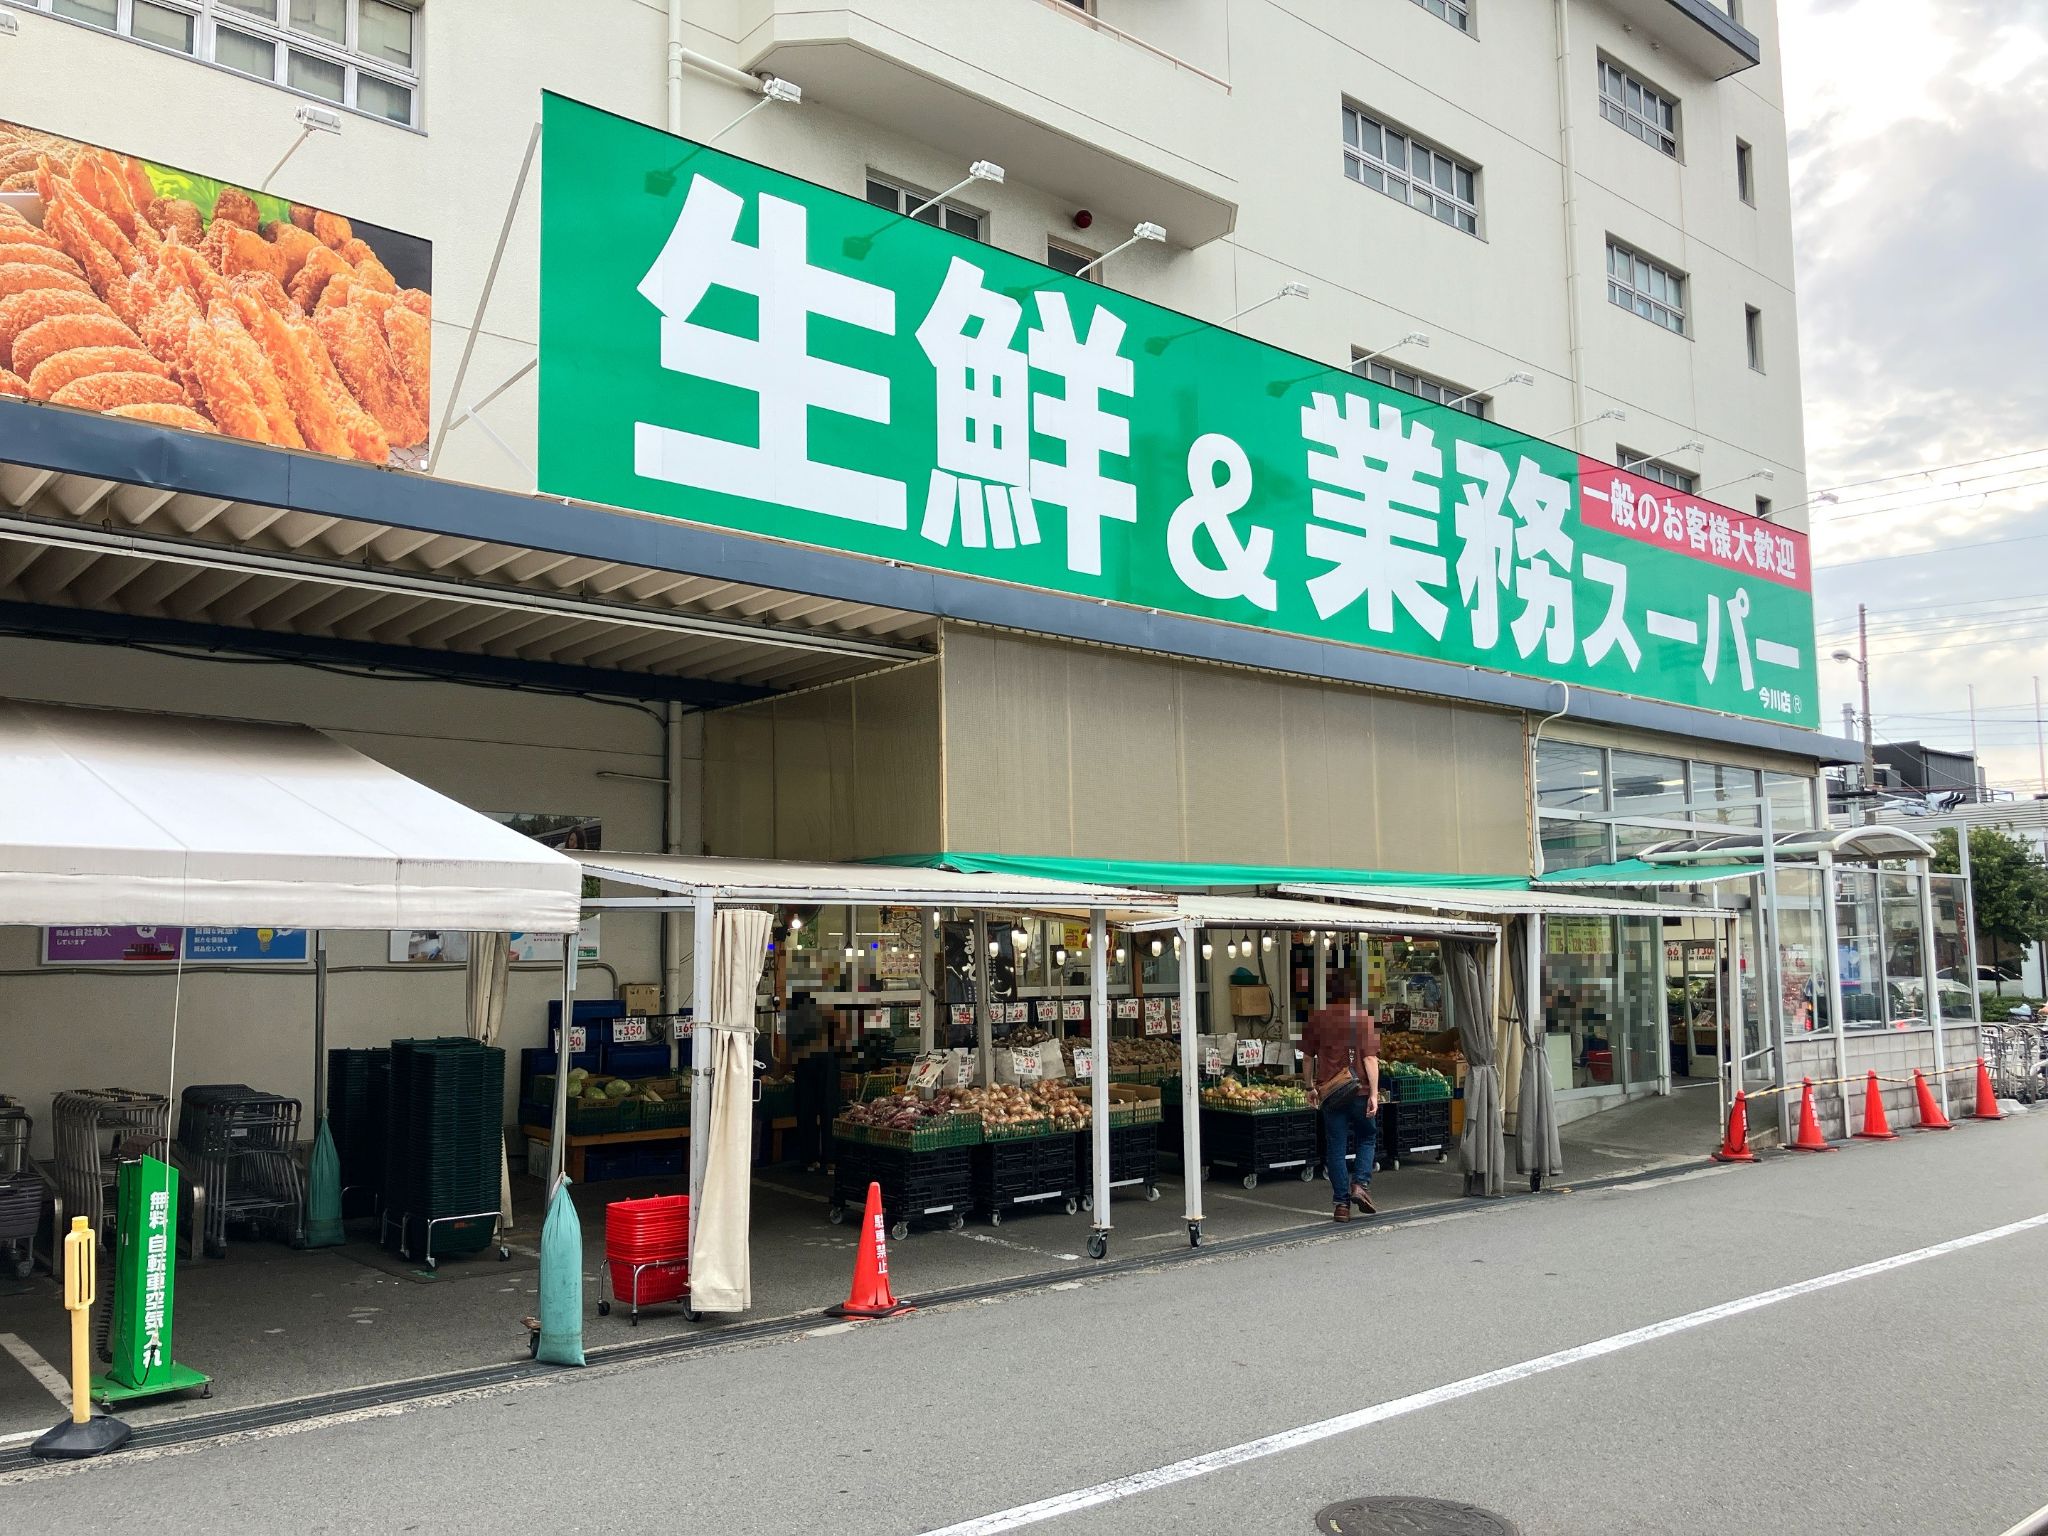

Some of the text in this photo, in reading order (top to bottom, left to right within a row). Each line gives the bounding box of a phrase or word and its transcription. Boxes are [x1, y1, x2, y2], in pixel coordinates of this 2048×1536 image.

[1583, 478, 1796, 580] 一般のお客様大歓迎
[1758, 686, 1791, 714] 今川店
[623, 1025, 642, 1036] 350
[1418, 1018, 1435, 1027] 259
[149, 1191, 169, 1230] 無料
